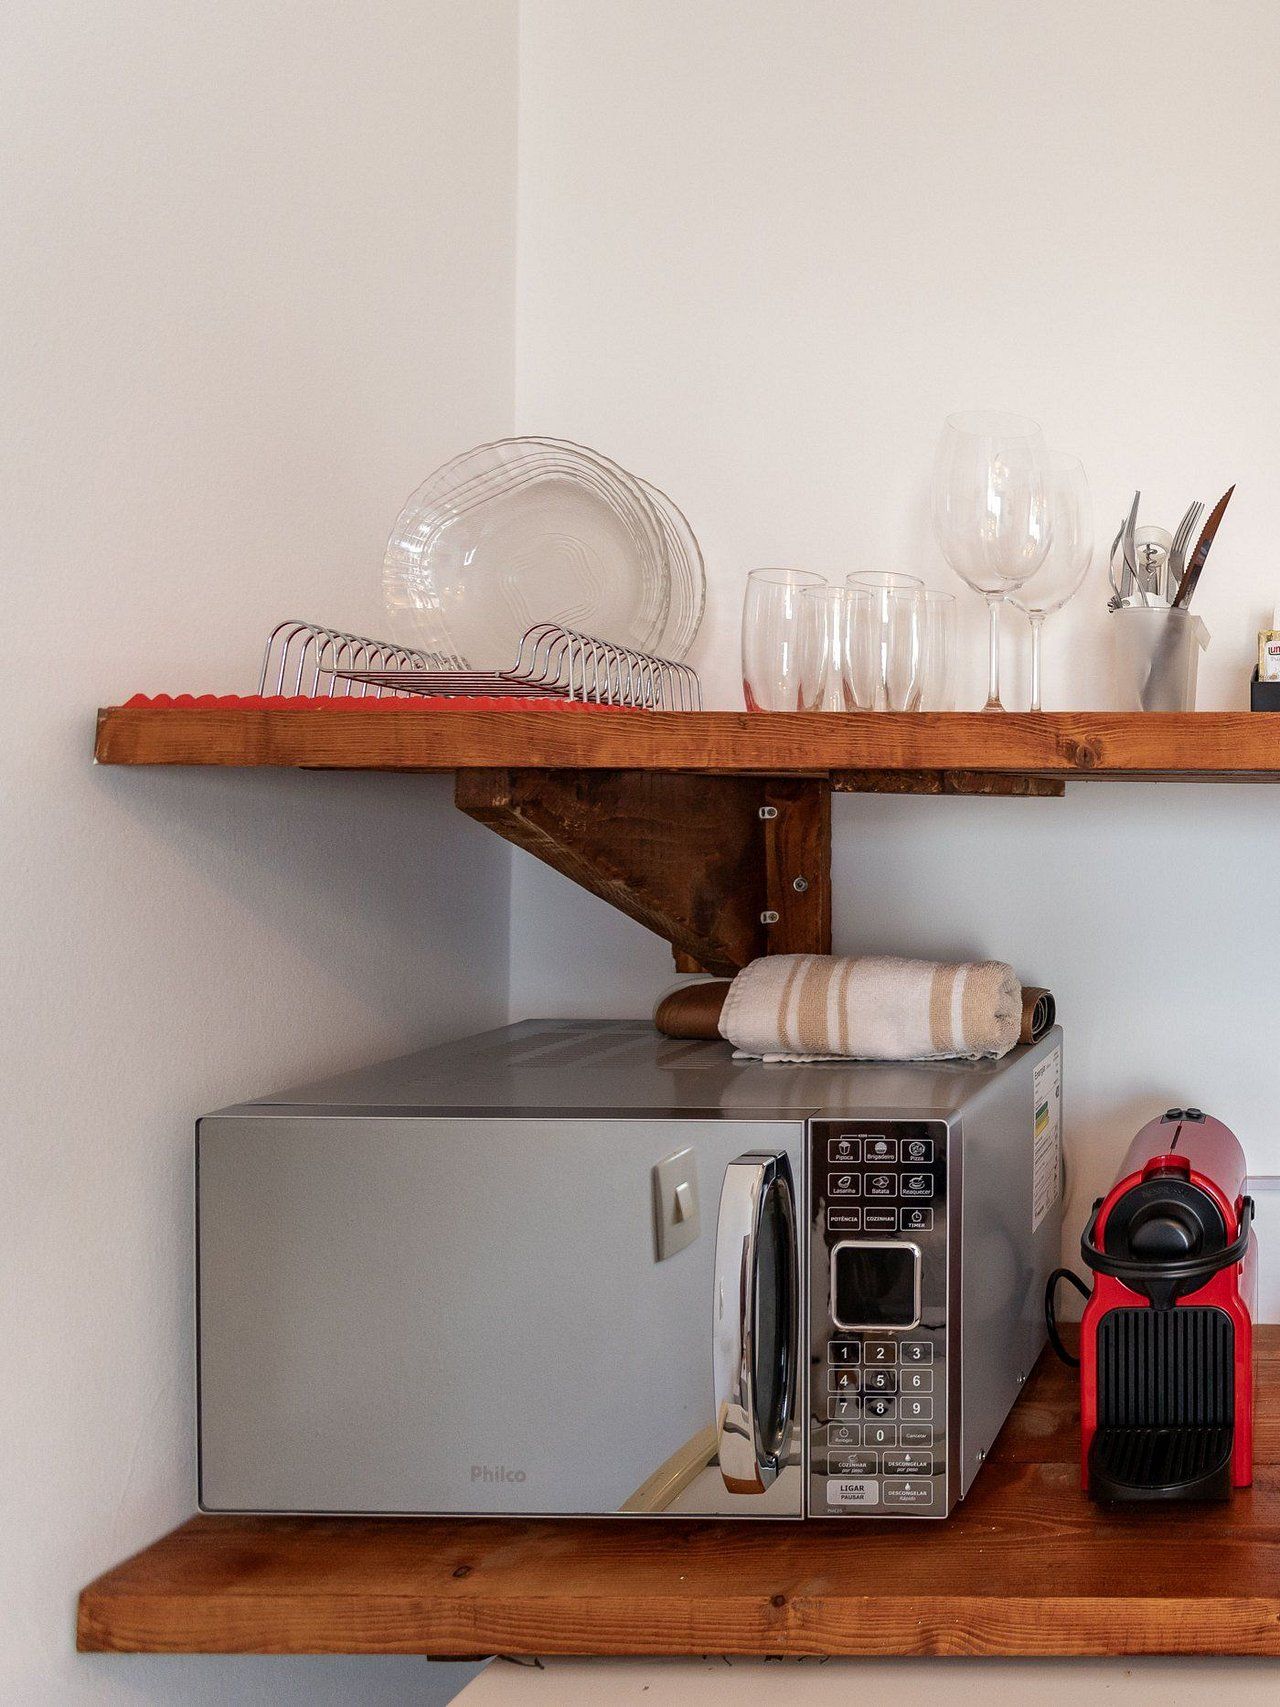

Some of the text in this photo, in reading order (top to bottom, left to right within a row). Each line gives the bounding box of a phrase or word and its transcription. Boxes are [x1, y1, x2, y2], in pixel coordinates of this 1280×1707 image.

[841, 1348, 848, 1359] 1
[876, 1348, 885, 1359] 2
[912, 1348, 921, 1359] 3
[840, 1375, 848, 1386] 4
[876, 1375, 885, 1386] 5
[912, 1375, 921, 1386] 6
[840, 1402, 848, 1414] 7
[876, 1402, 885, 1414] 8
[912, 1402, 921, 1414] 9
[876, 1429, 885, 1441] 0
[470, 1465, 527, 1483] Philco
[840, 1484, 865, 1492] LIGAR
